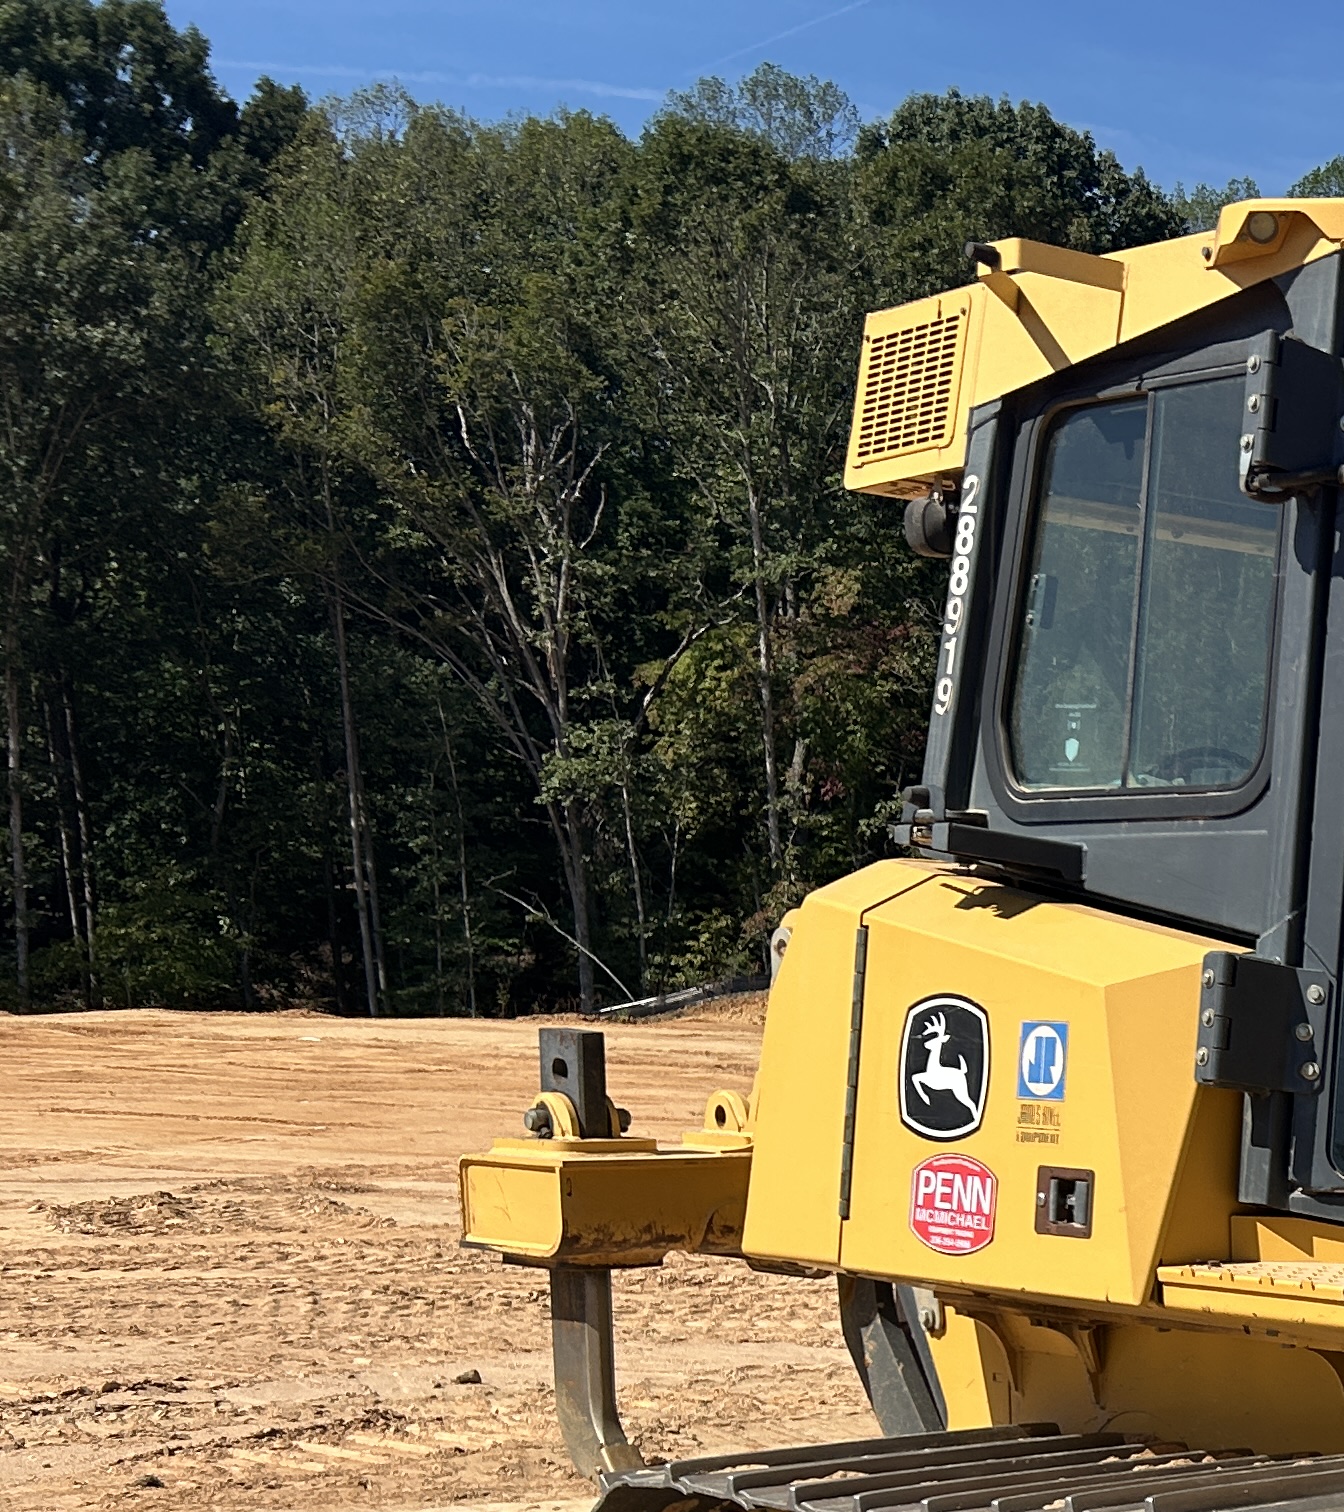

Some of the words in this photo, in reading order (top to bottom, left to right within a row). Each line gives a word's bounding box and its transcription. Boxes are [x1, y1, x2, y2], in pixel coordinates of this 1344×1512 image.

[935, 474, 980, 715] 288919
[917, 1170, 991, 1214] PENN
[915, 1208, 989, 1230] MCMICHAEL
